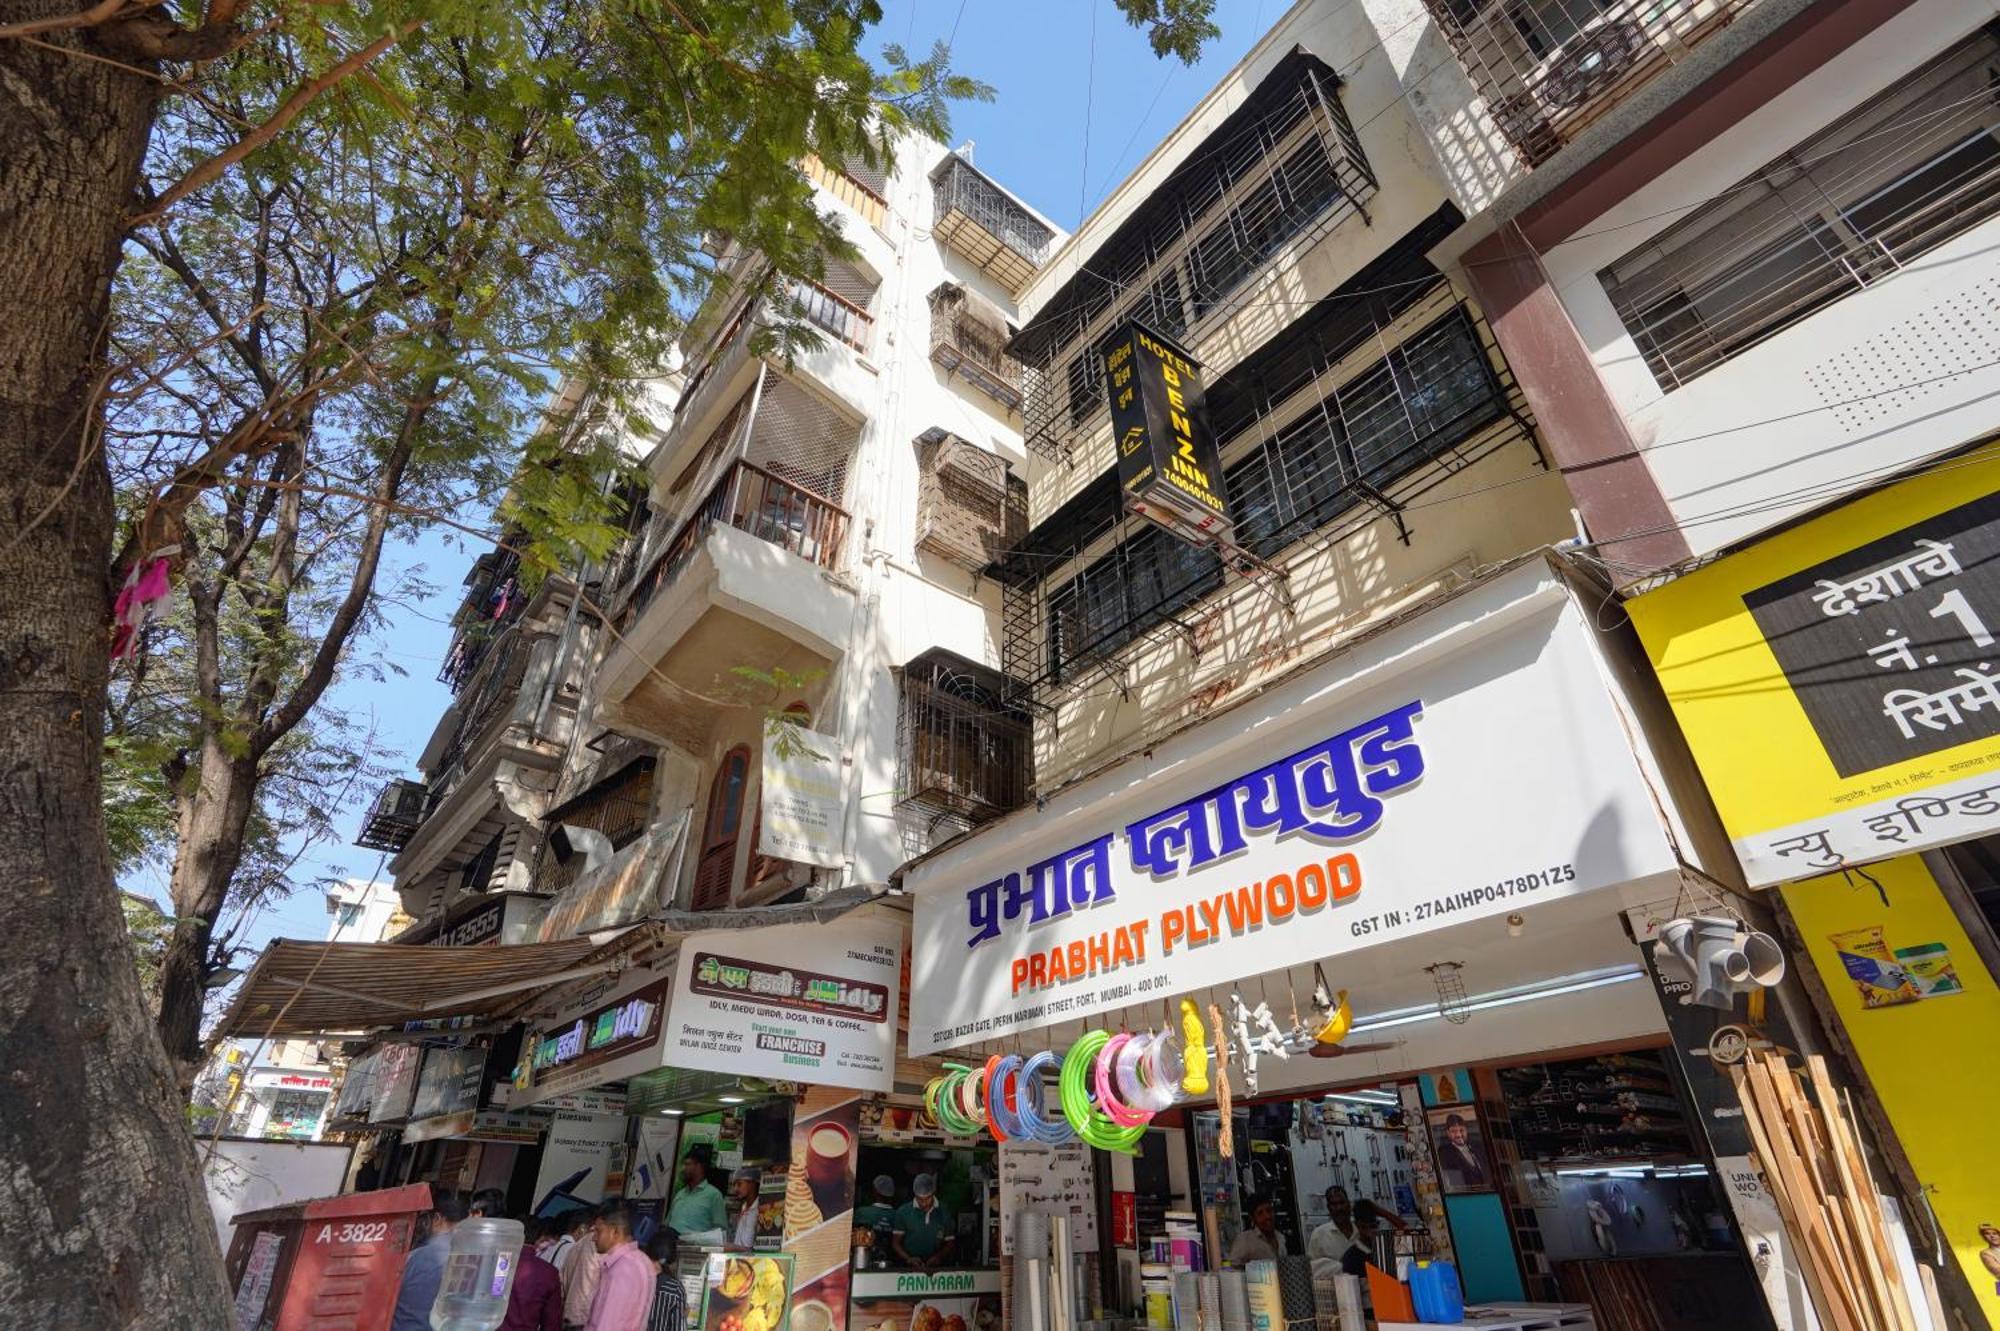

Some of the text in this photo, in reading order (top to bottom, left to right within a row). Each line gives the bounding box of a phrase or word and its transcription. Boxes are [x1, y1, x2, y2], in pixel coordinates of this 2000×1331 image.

[1139, 333, 1196, 380] HOTEL
[1162, 362, 1197, 464] BENZ
[1171, 454, 1209, 489] INN
[1812, 538, 1963, 617] देशाचे
[1929, 588, 1996, 648] 1
[1882, 661, 2000, 739] सिमें
[967, 699, 1425, 948] प्रभात प्लायवुड
[1862, 784, 2000, 843] इण्डि
[1350, 916, 1380, 937] GST
[1385, 910, 1402, 928] IN
[1414, 864, 1576, 921] 27AAIHP0478D1Z5
[1011, 852, 1362, 1000] PRABHAT PLYWOOD
[1076, 992, 1097, 1008] FORT,
[1100, 982, 1132, 1003] MUMBAI
[1138, 978, 1153, 992] 400
[1663, 981, 1693, 995] PRO
[709, 1000, 729, 1012] IDLY,
[731, 1004, 756, 1015] MEDU
[811, 1014, 826, 1025] TEA
[760, 1034, 823, 1055] FRANCHISE
[783, 1053, 821, 1067] Business
[1731, 1172, 1757, 1183] UNL
[1734, 1182, 1758, 1192] WO
[315, 1222, 388, 1244] A-3822
[897, 1274, 976, 1292] PANIYARAM
